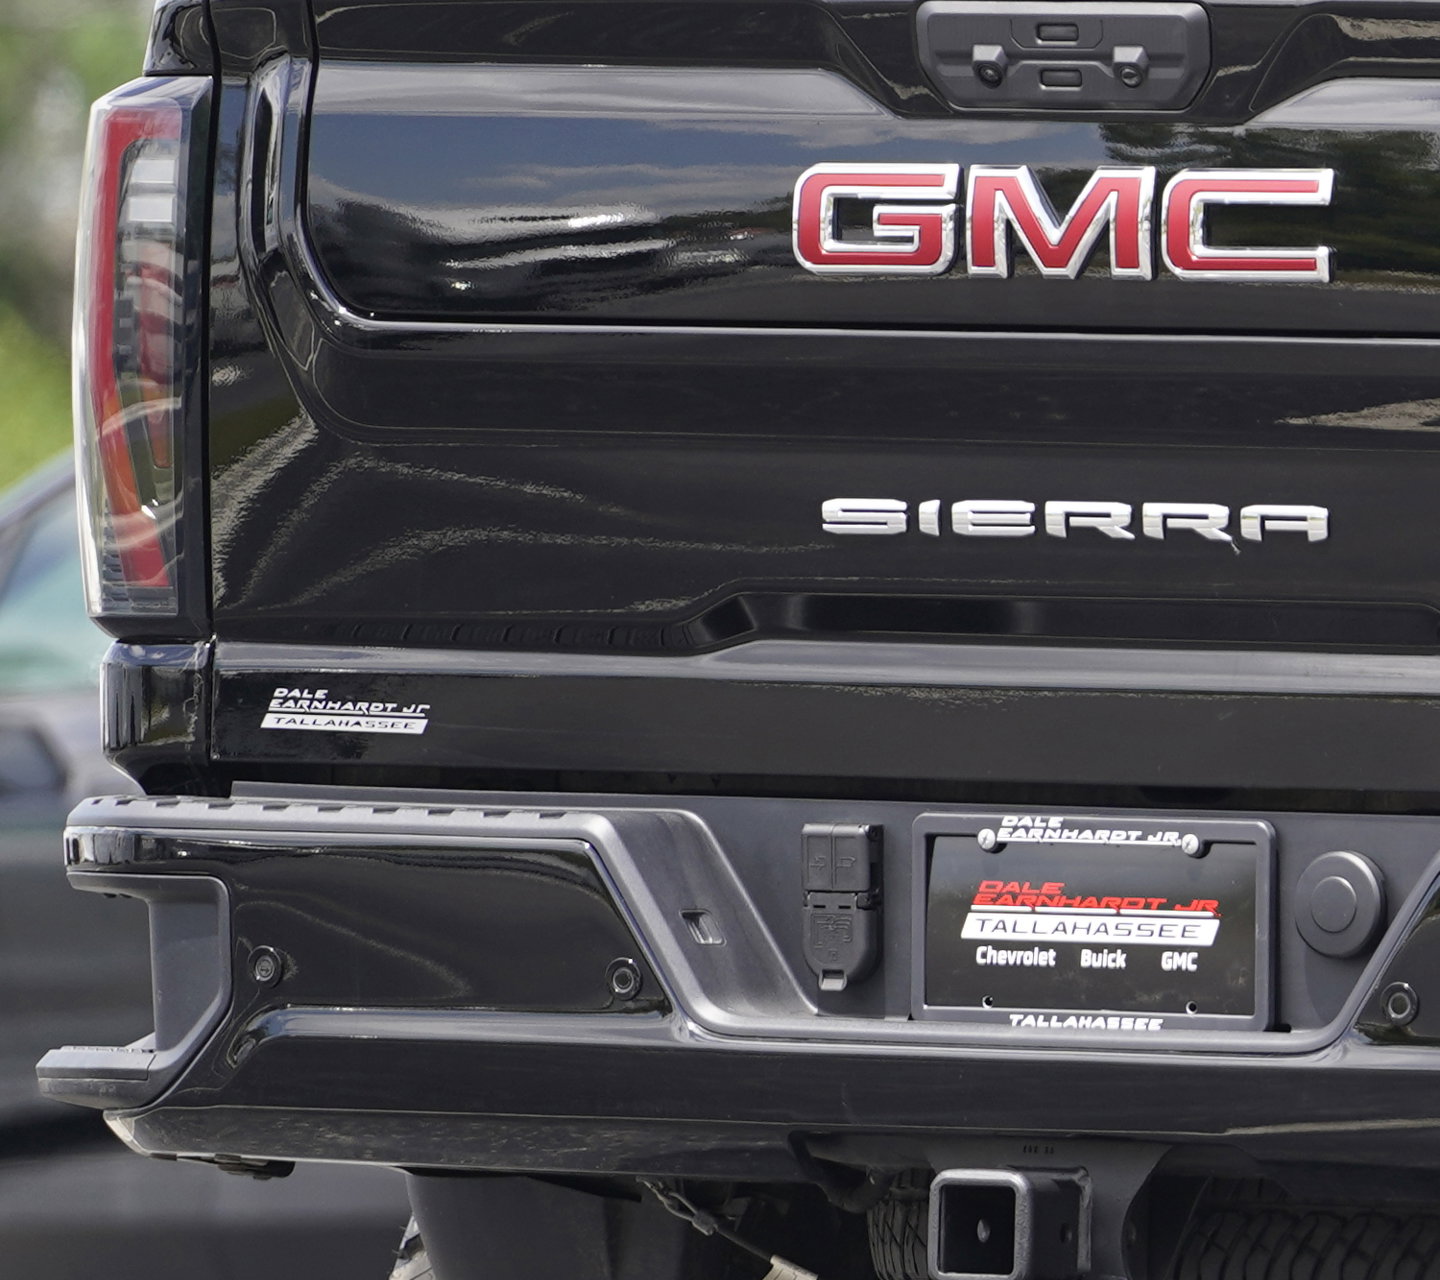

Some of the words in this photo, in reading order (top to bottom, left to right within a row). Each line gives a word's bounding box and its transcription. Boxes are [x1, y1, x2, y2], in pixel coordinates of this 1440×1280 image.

[792, 162, 1334, 283] GMC
[821, 497, 1329, 542] SIERRA
[273, 687, 328, 699] DALE
[269, 698, 397, 715] EARNHARDT
[273, 716, 417, 730] TALLAHASSEE
[1001, 816, 1063, 828] DALE
[997, 827, 1142, 843] EARNHARDT
[978, 880, 1065, 895] DALE
[973, 894, 1167, 912] EARNHARDT
[976, 919, 1201, 939] TALLAHASSEE
[976, 946, 1056, 967] Chevrolet
[1080, 949, 1127, 969] Buick
[1161, 951, 1198, 971] GMC
[1010, 1014, 1164, 1031] TALLAHASSEE
